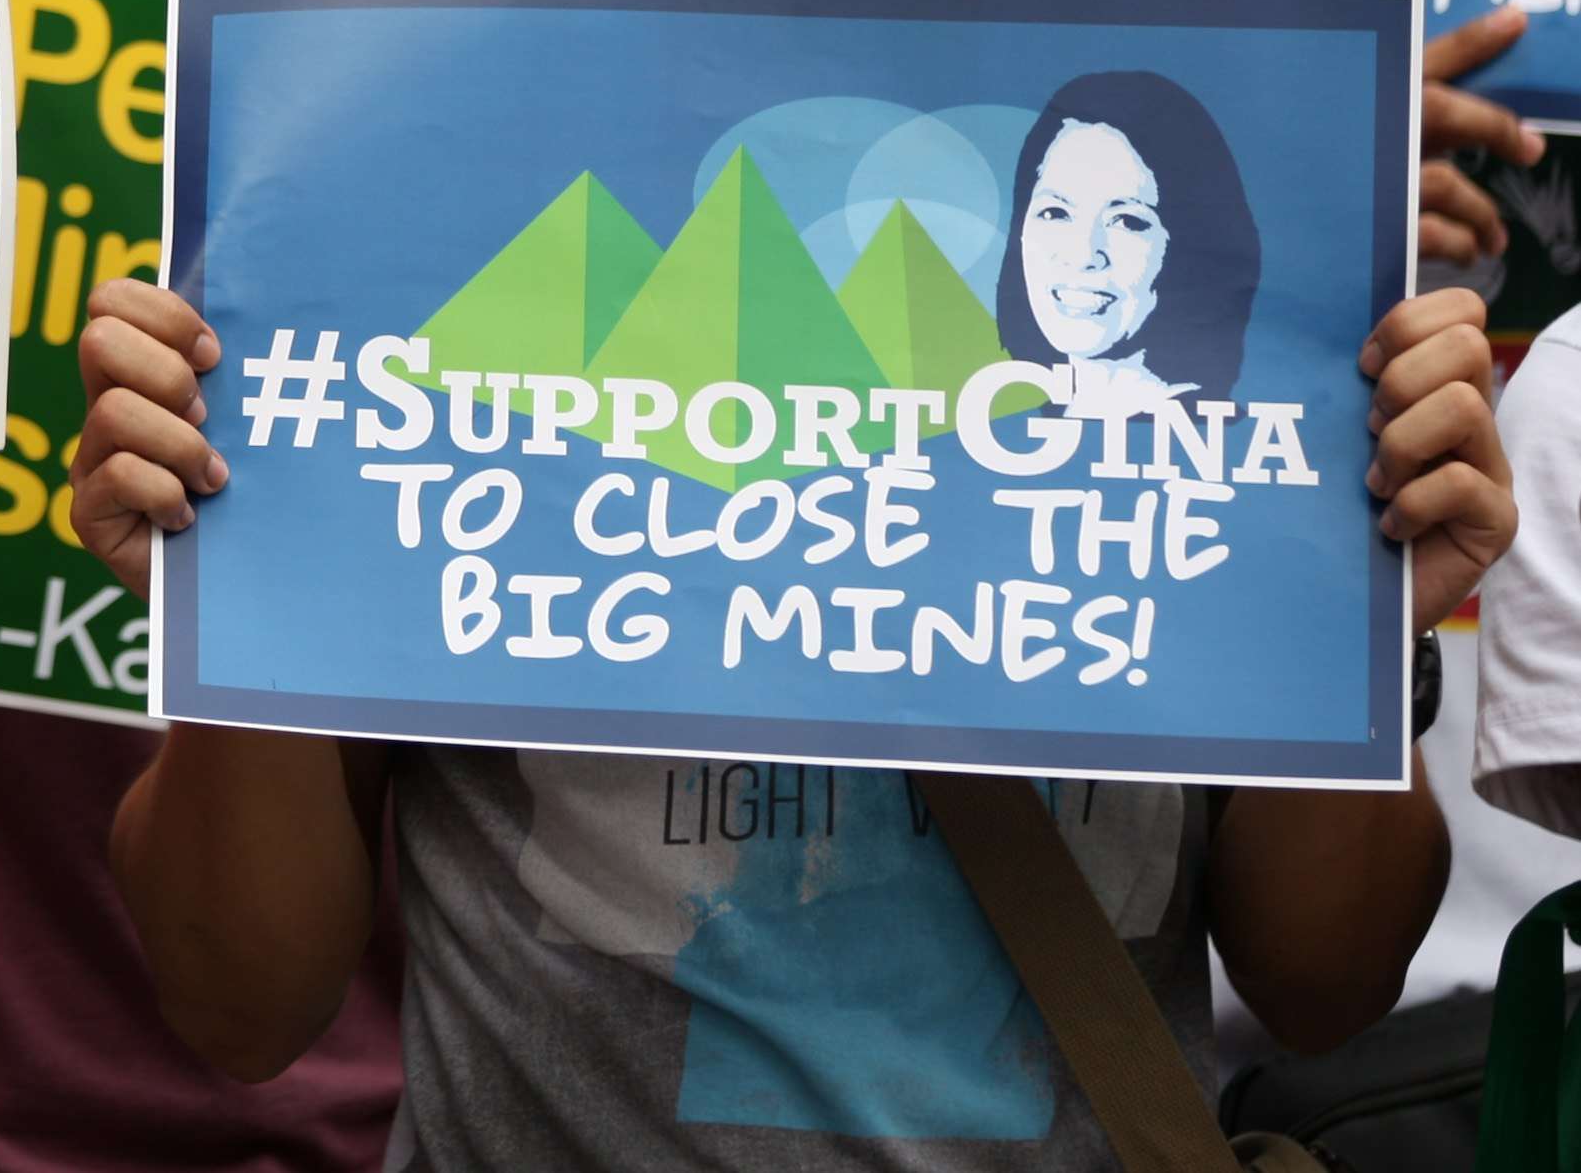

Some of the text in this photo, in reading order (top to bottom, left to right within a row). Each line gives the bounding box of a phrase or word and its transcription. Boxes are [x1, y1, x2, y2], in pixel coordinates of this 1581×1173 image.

[360, 462, 1236, 581] TO CLOSE THE
[441, 554, 1156, 688] BIG MINES!
